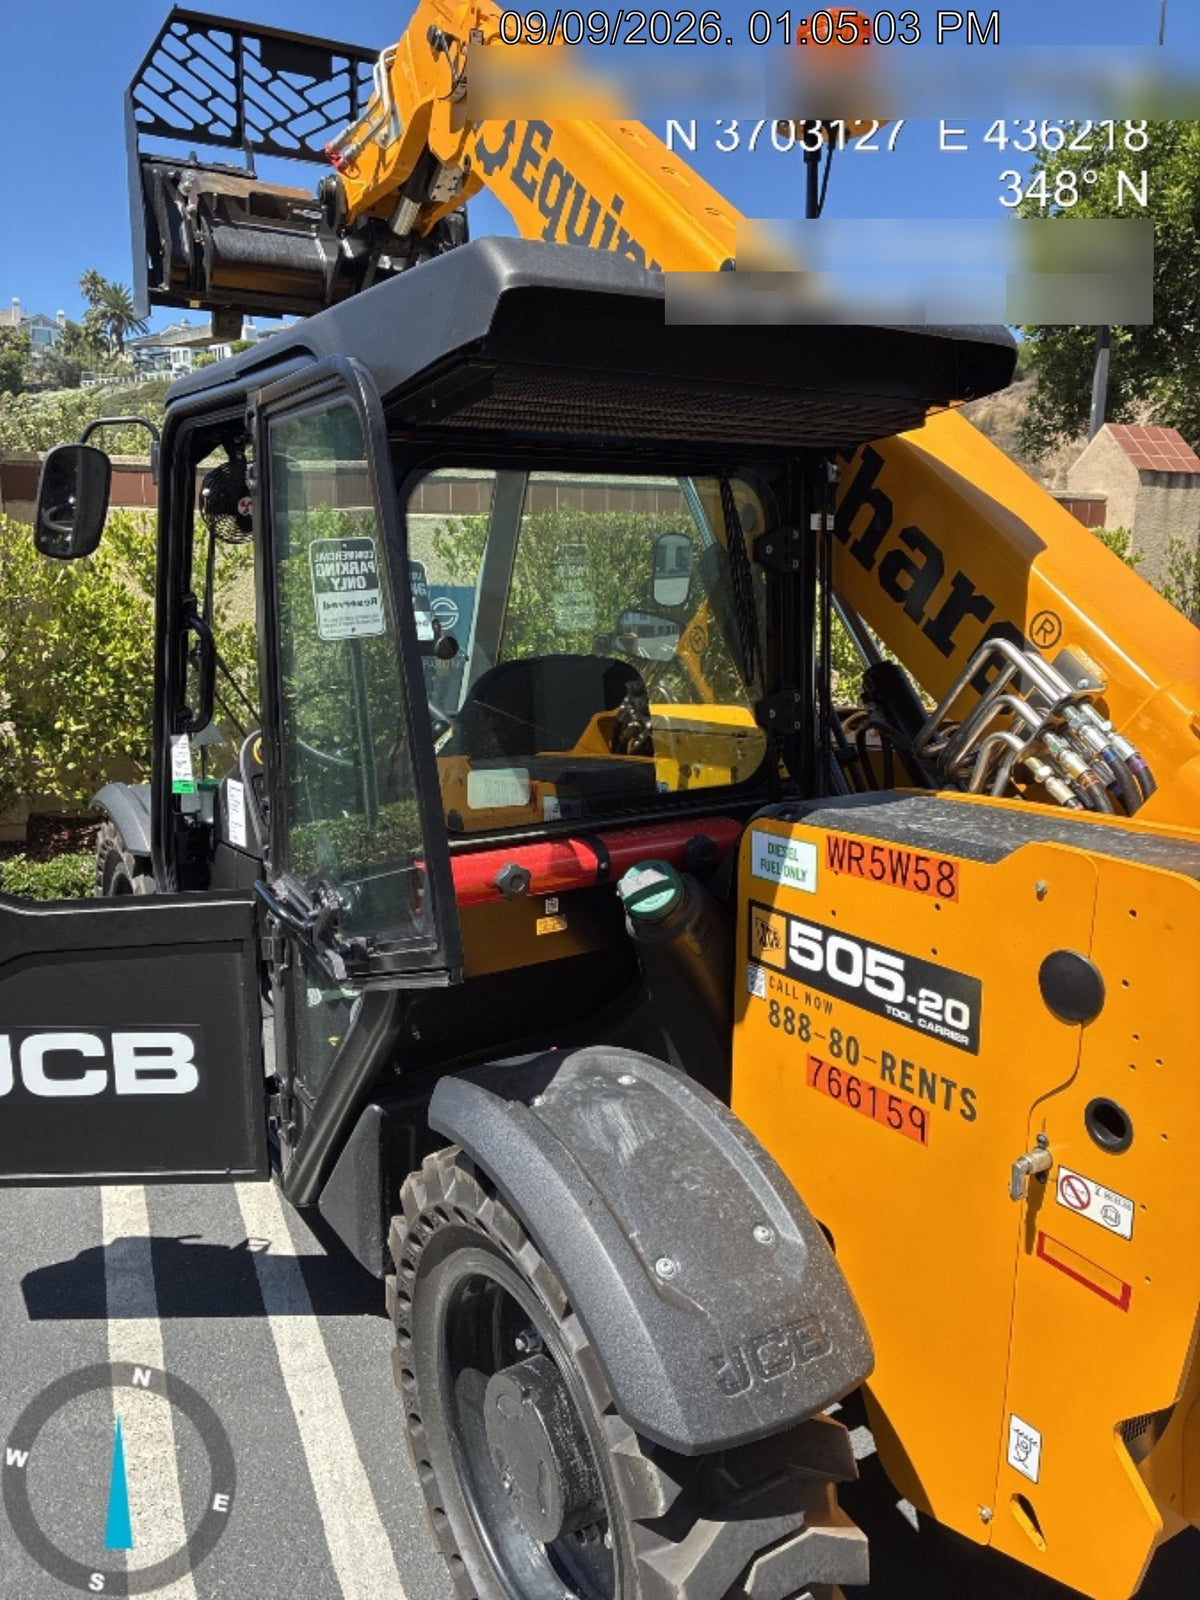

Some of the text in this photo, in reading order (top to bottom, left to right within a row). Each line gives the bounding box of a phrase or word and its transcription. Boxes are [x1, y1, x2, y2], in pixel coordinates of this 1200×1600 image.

[760, 858, 807, 882] FUEL ONLY
[767, 842, 799, 861] DIESEL
[827, 835, 957, 899] WR5W58
[769, 976, 833, 1016] CALL NOW
[885, 1004, 970, 1046] TOOL CARRIER
[0, 1032, 200, 1097] CB
[768, 999, 978, 1122] 888-80-RENTS
[810, 1056, 928, 1143] 766159
[709, 1315, 833, 1398] JCB
